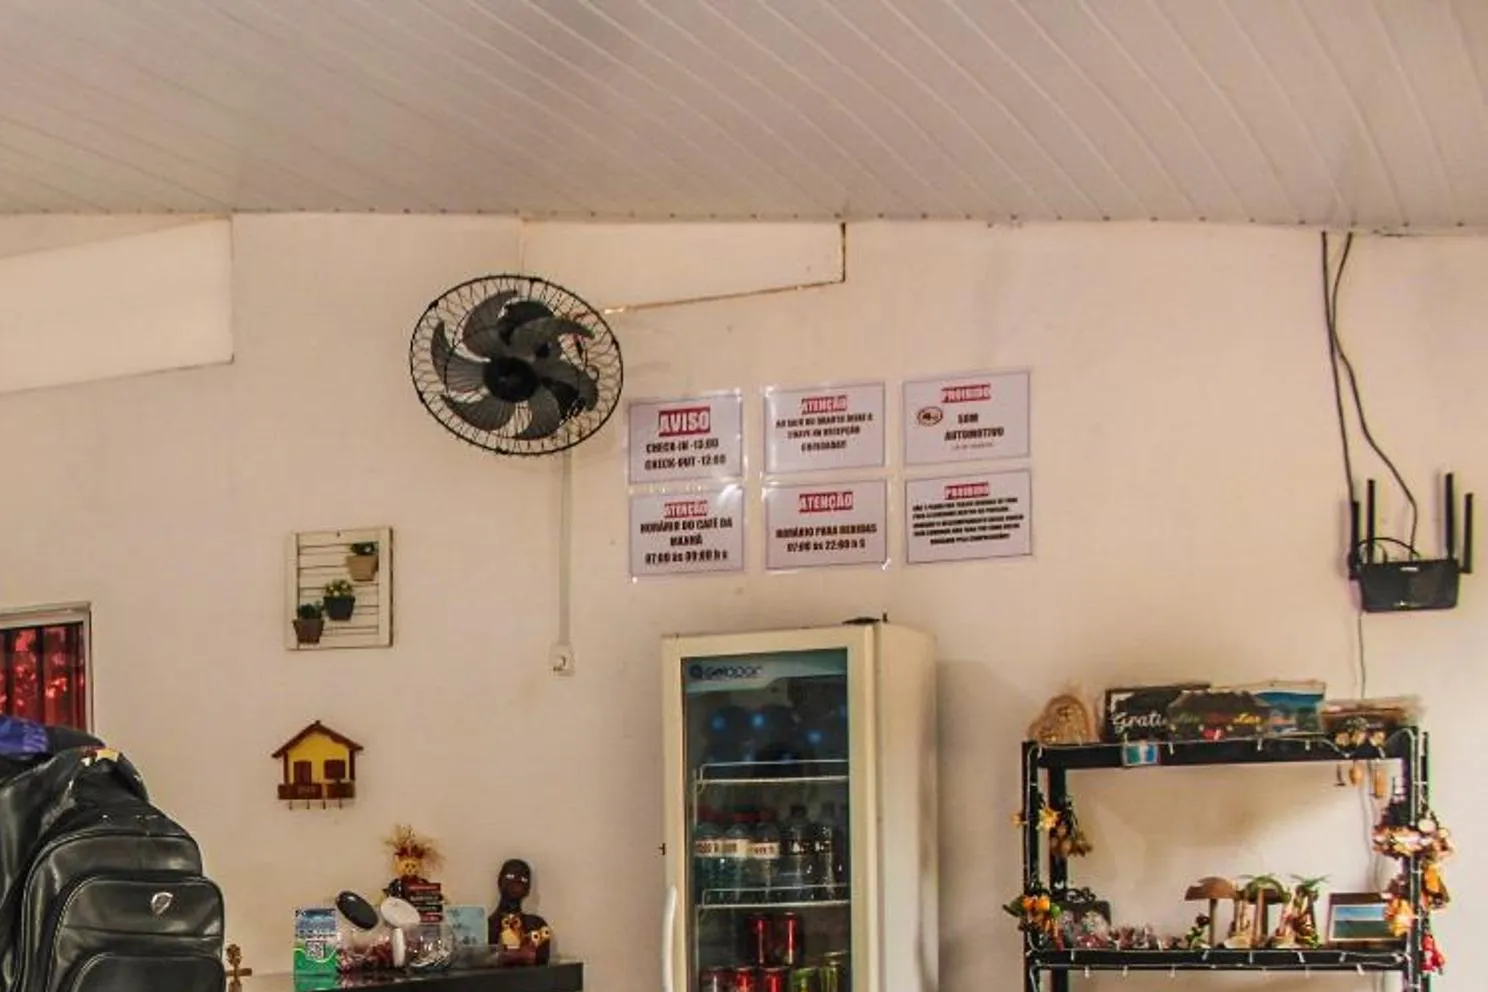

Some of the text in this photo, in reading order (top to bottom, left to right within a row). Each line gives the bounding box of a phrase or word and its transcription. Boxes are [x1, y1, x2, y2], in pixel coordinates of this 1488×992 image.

[660, 410, 710, 433] AVISO
[944, 427, 1004, 441] AUTOMOTIVO
[800, 493, 853, 512] ATENÇÃO
[1113, 710, 1168, 734] Grati
